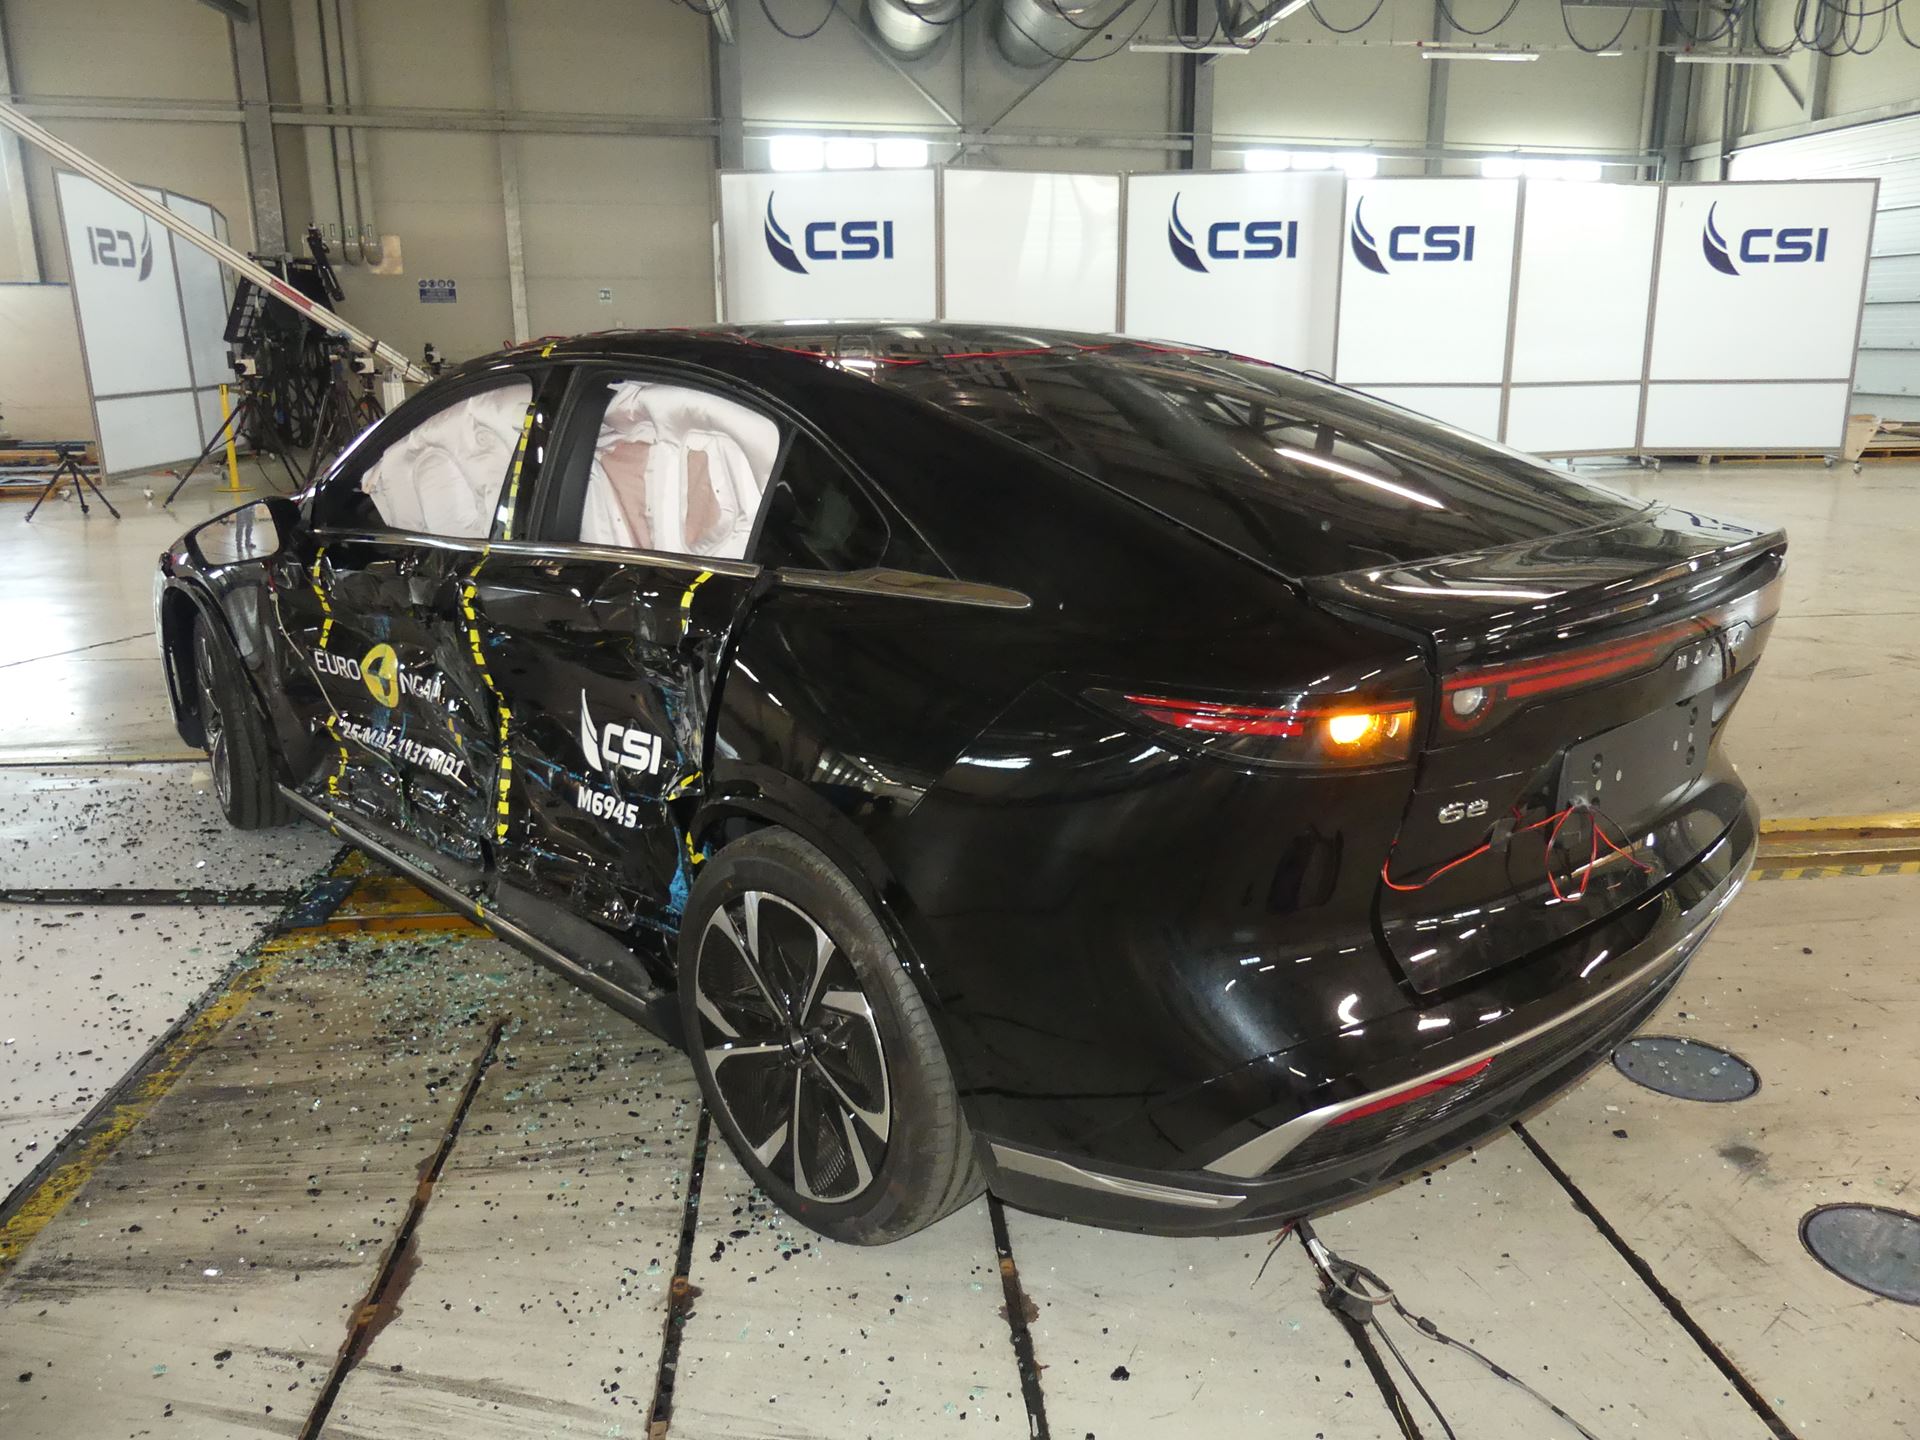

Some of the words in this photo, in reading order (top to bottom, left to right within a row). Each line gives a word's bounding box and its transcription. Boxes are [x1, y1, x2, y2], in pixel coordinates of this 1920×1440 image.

[806, 221, 893, 260] CSI
[1208, 221, 1297, 260] CSI
[1388, 225, 1474, 262] CSI
[1740, 228, 1828, 263] CSI
[314, 650, 361, 681] EURO
[602, 722, 662, 775] CSI
[577, 785, 639, 829] M6945
